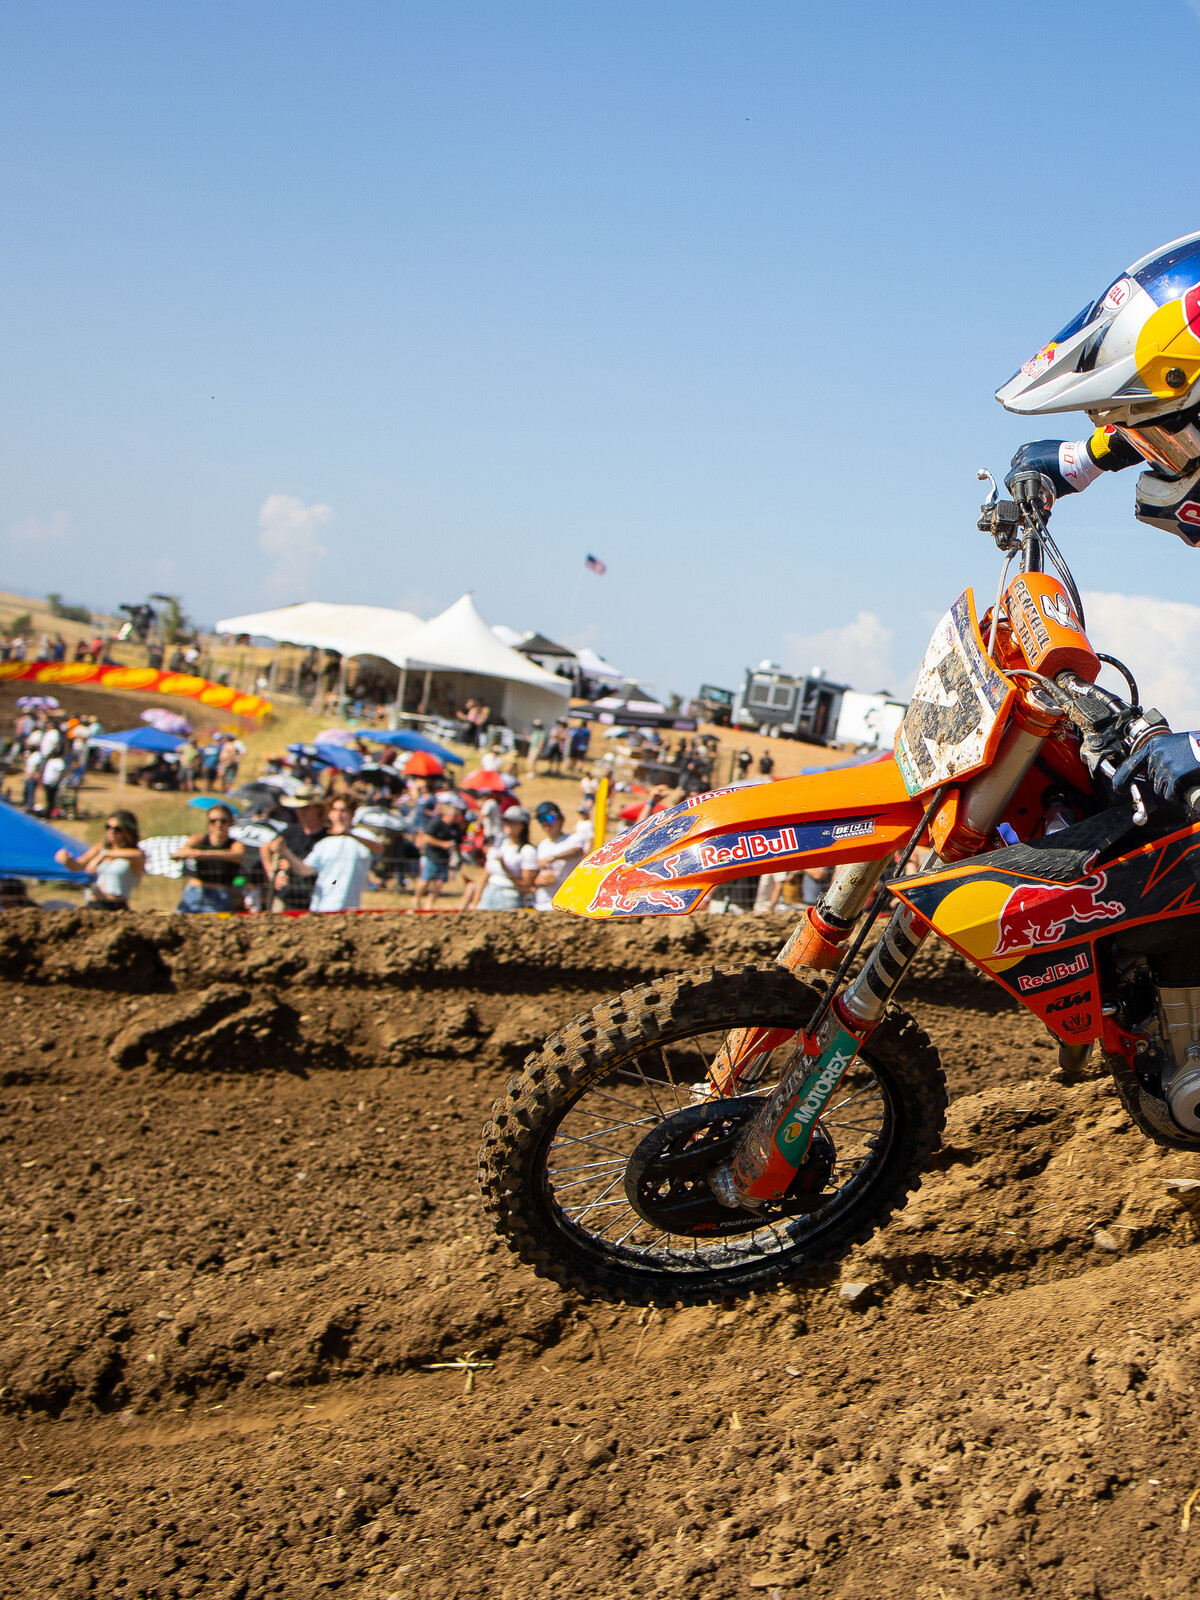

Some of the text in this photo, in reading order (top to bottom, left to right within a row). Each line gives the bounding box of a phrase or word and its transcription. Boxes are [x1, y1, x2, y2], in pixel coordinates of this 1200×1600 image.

[1107, 284, 1127, 306] BELL
[1013, 579, 1052, 652] RENTHAL
[836, 822, 874, 835] DECAL
[701, 827, 799, 870] Red Bull
[1018, 952, 1089, 992] Red Bull
[1045, 990, 1092, 1014] KTM
[793, 1049, 853, 1124] MOTOREX
[719, 1216, 773, 1228] POWERPART
